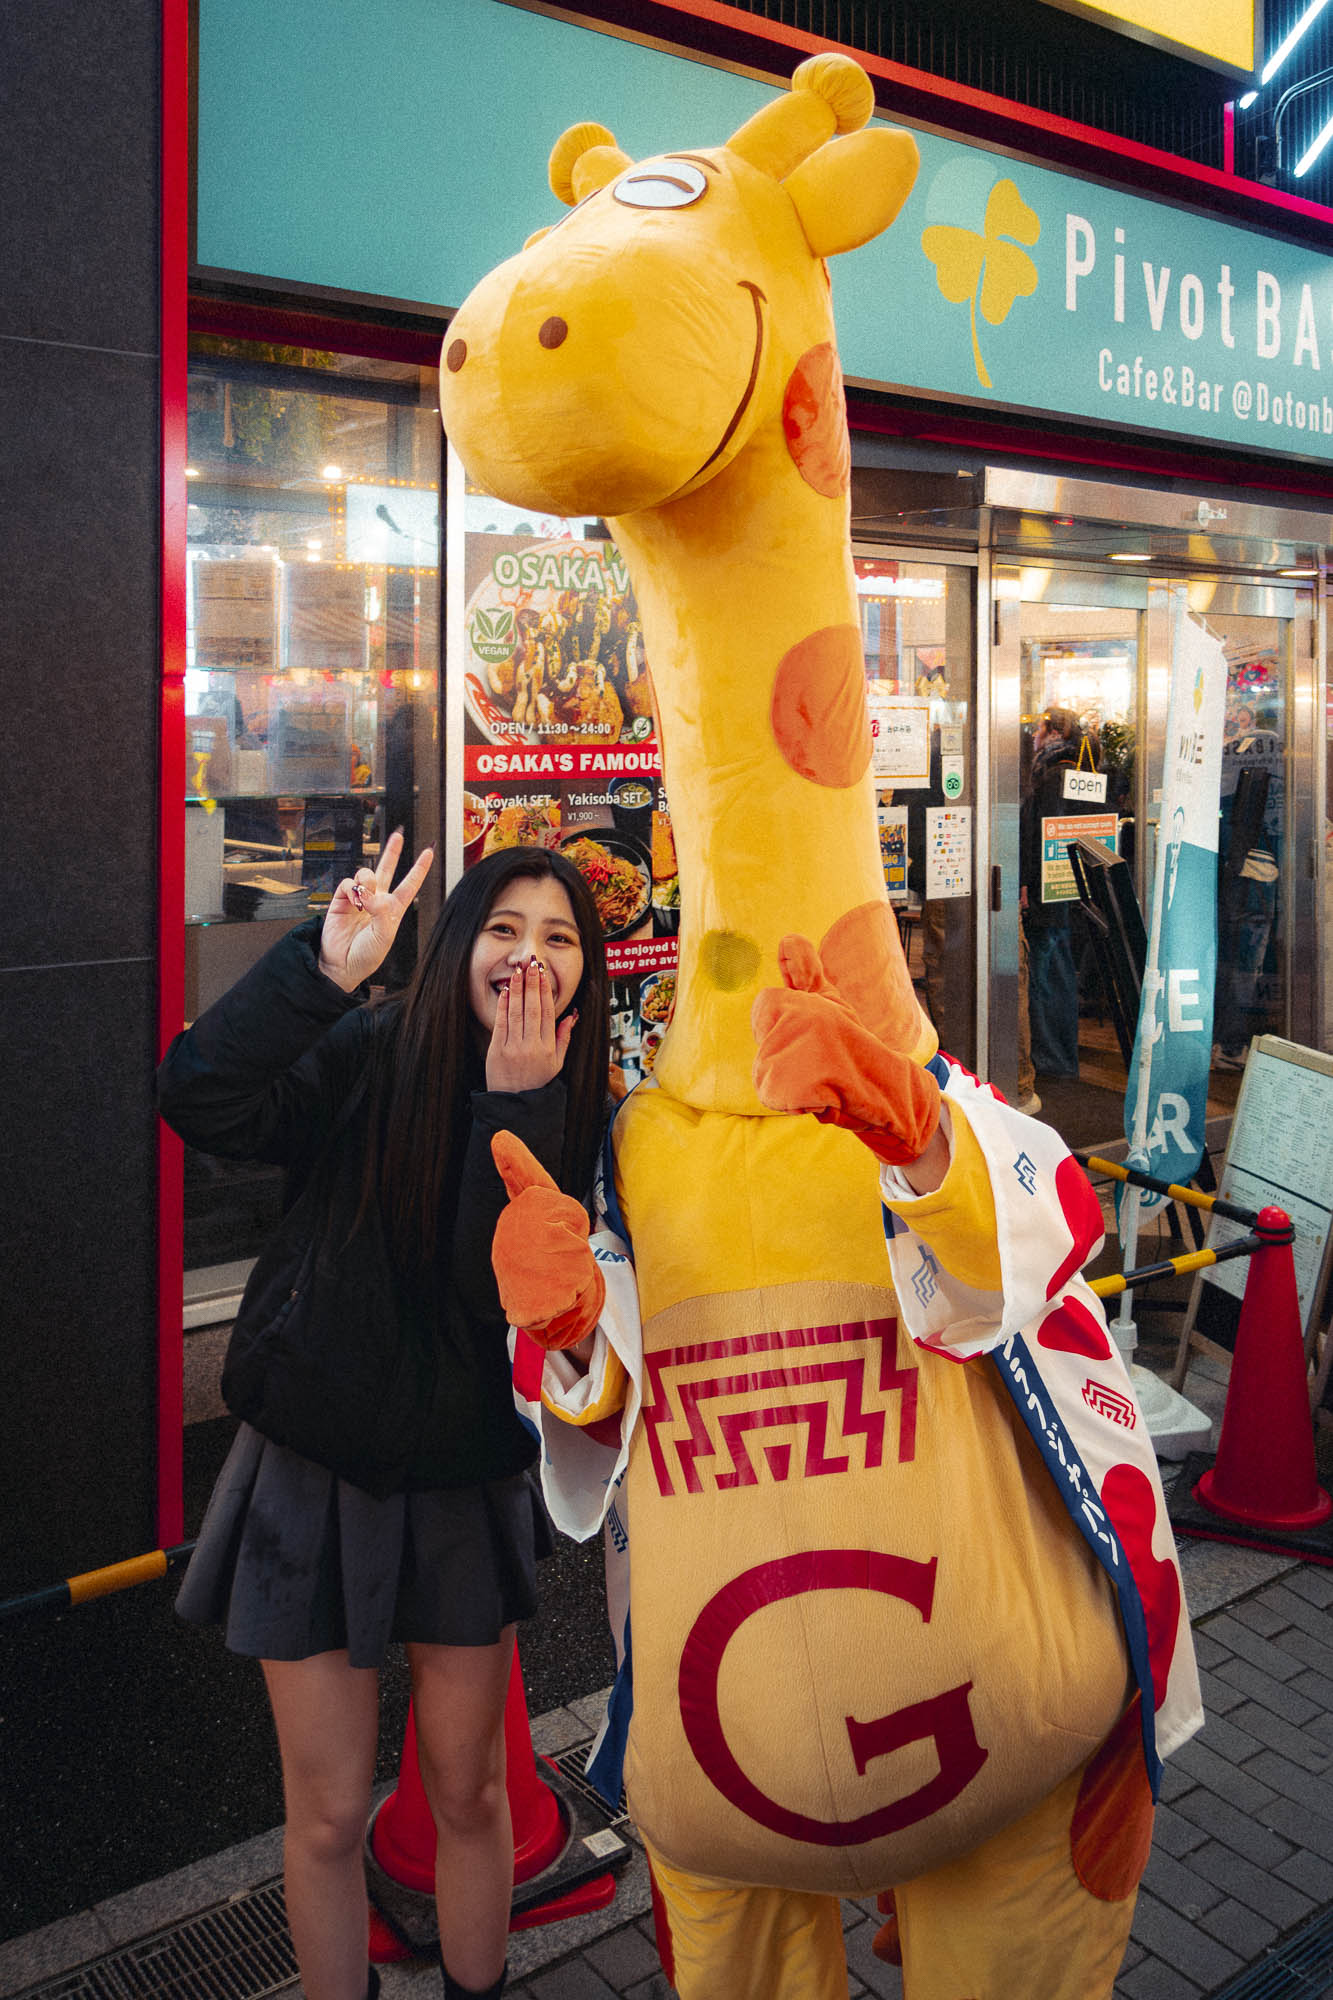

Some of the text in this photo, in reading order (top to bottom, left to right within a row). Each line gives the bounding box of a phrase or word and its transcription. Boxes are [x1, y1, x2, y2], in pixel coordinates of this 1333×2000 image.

[1065, 213, 1333, 370] Pivot BA
[1099, 348, 1224, 413] Cafe&Bar
[494, 553, 606, 591] OSAKA
[478, 645, 509, 656] VEGAN
[490, 723, 524, 734] OPEN
[476, 754, 573, 773] OSAKA'S
[1069, 778, 1102, 795] open
[471, 794, 551, 810] Takoyaki SET
[568, 792, 643, 806] Yakisoba SET
[607, 947, 621, 957] be
[624, 942, 669, 956] enjoyed
[638, 958, 657, 967] are
[678, 1548, 989, 1847] G
